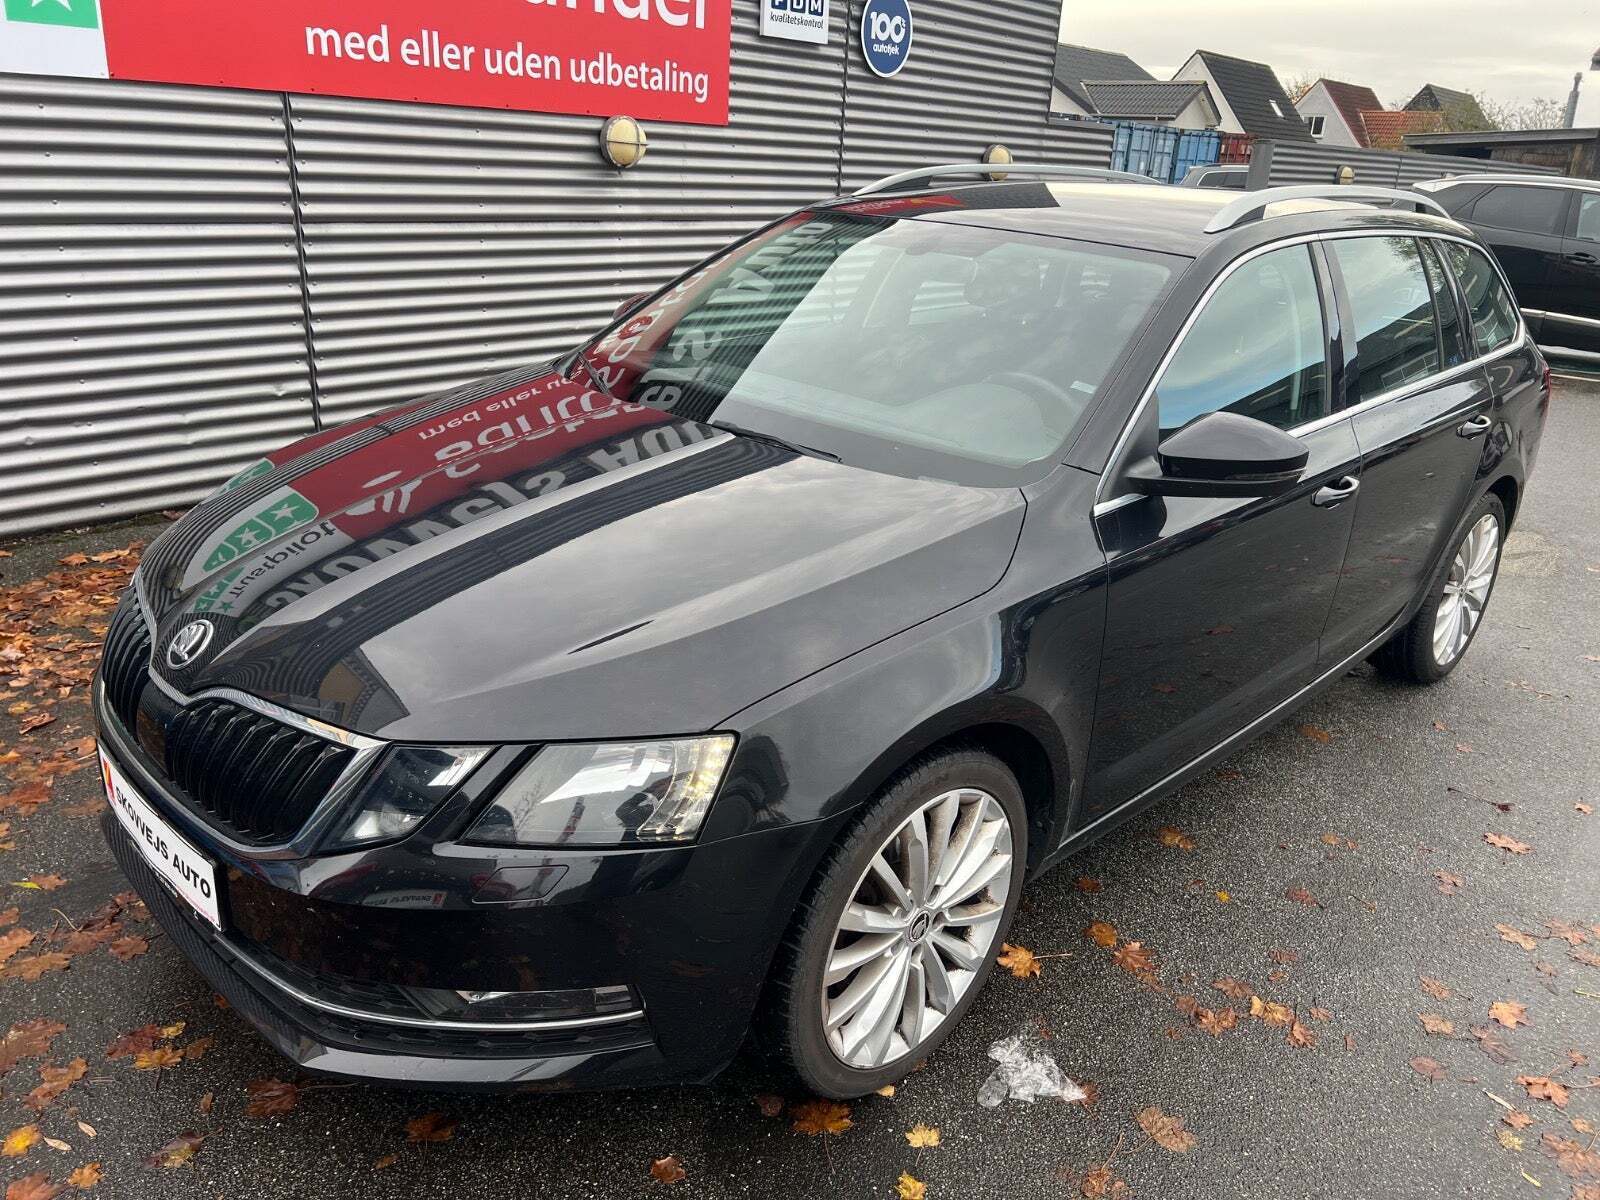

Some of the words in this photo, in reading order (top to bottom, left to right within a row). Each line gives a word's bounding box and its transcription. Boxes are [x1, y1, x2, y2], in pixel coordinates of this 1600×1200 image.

[770, 11, 823, 29] kvalitetskontrol
[305, 24, 391, 63] med
[400, 29, 476, 72] eller
[484, 41, 562, 81] uden
[569, 51, 710, 103] udbetaling
[872, 43, 900, 56] autotjek
[116, 786, 169, 861] SKOVVEJS
[172, 852, 211, 899] AUTO
